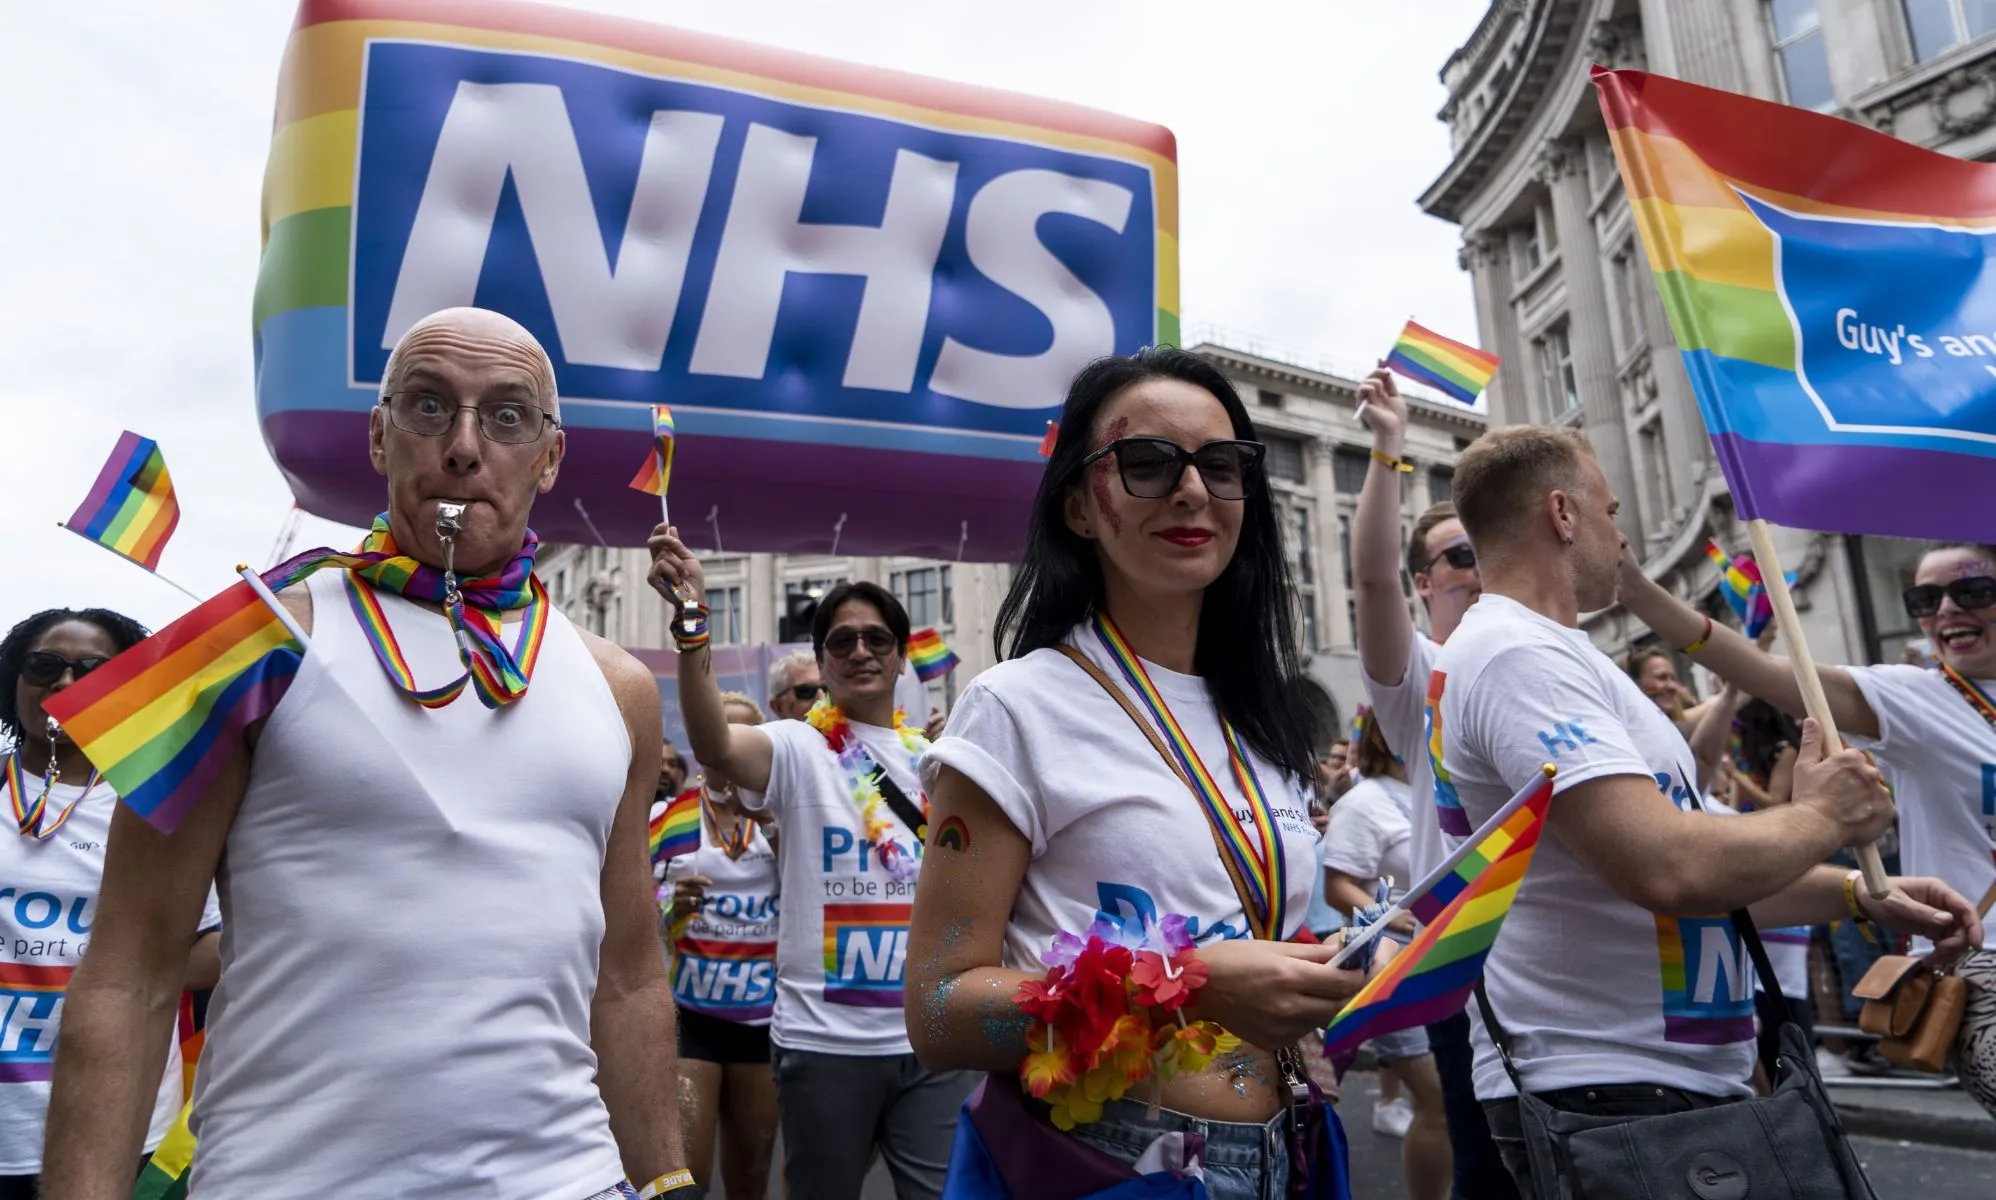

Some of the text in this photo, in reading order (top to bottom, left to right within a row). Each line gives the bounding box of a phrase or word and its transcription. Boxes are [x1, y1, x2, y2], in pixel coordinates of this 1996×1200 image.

[381, 80, 1134, 409] NHS
[1836, 307, 1996, 365] Guy's an
[69, 841, 101, 851] Guy's
[824, 879, 845, 897] to
[853, 876, 877, 897] be
[14, 937, 68, 960] part
[1693, 926, 1755, 1003] N
[677, 957, 772, 1001] NHS
